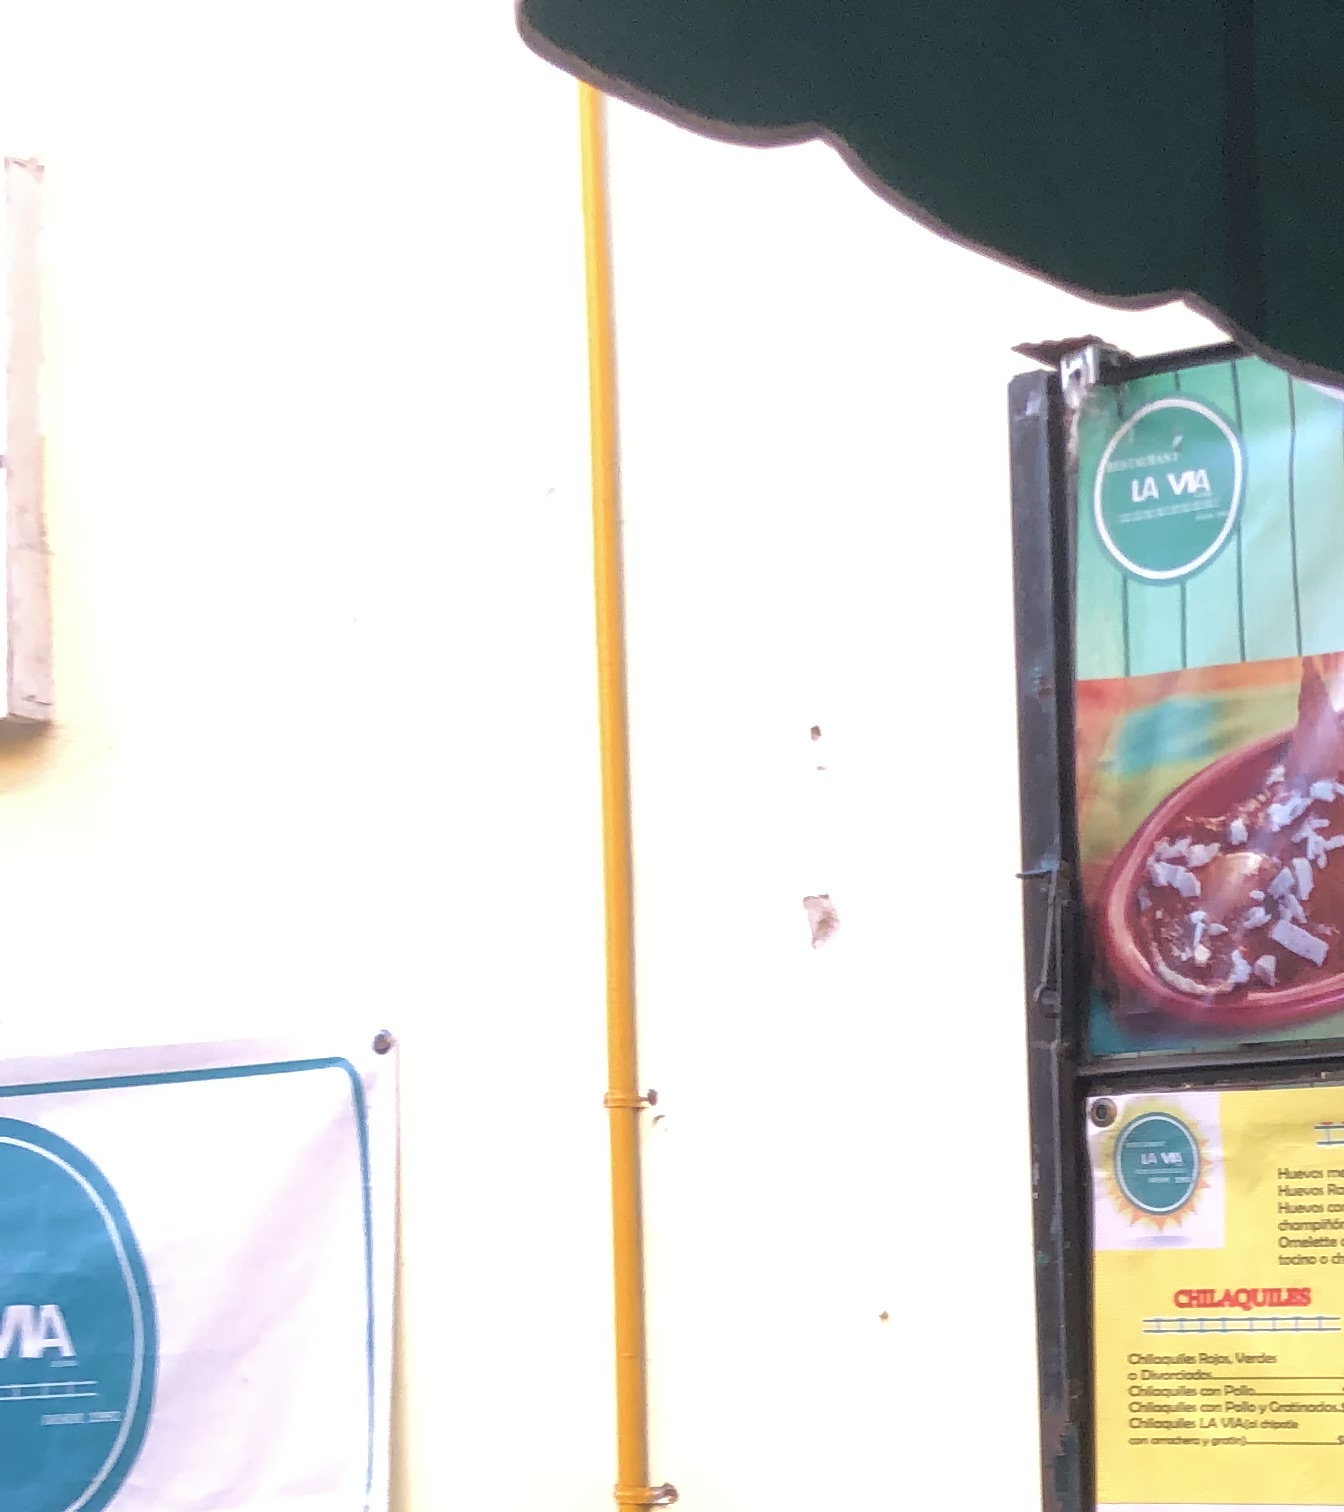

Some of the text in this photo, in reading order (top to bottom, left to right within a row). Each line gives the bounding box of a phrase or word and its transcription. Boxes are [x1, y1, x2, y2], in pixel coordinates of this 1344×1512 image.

[1131, 469, 1211, 503] LA VIA
[1278, 1167, 1324, 1179] Huevos
[1278, 1185, 1324, 1197] Huevos
[1278, 1202, 1324, 1214] Huevos
[1320, 1255, 1329, 1264] o
[1174, 1287, 1311, 1311] CHILAQUILES
[1128, 1353, 1196, 1366] Chilaquiles
[1235, 1352, 1277, 1364] Verdes
[1128, 1372, 1137, 1381] o
[1128, 1385, 1197, 1398] Chilaquiles
[1200, 1387, 1221, 1396] con
[1224, 1385, 1255, 1397] Pollo
[1128, 1401, 1197, 1414] Chilaquiles
[1200, 1403, 1222, 1413] con
[1225, 1401, 1256, 1413] Pollo
[1128, 1418, 1217, 1431] Chilaquiles LA
